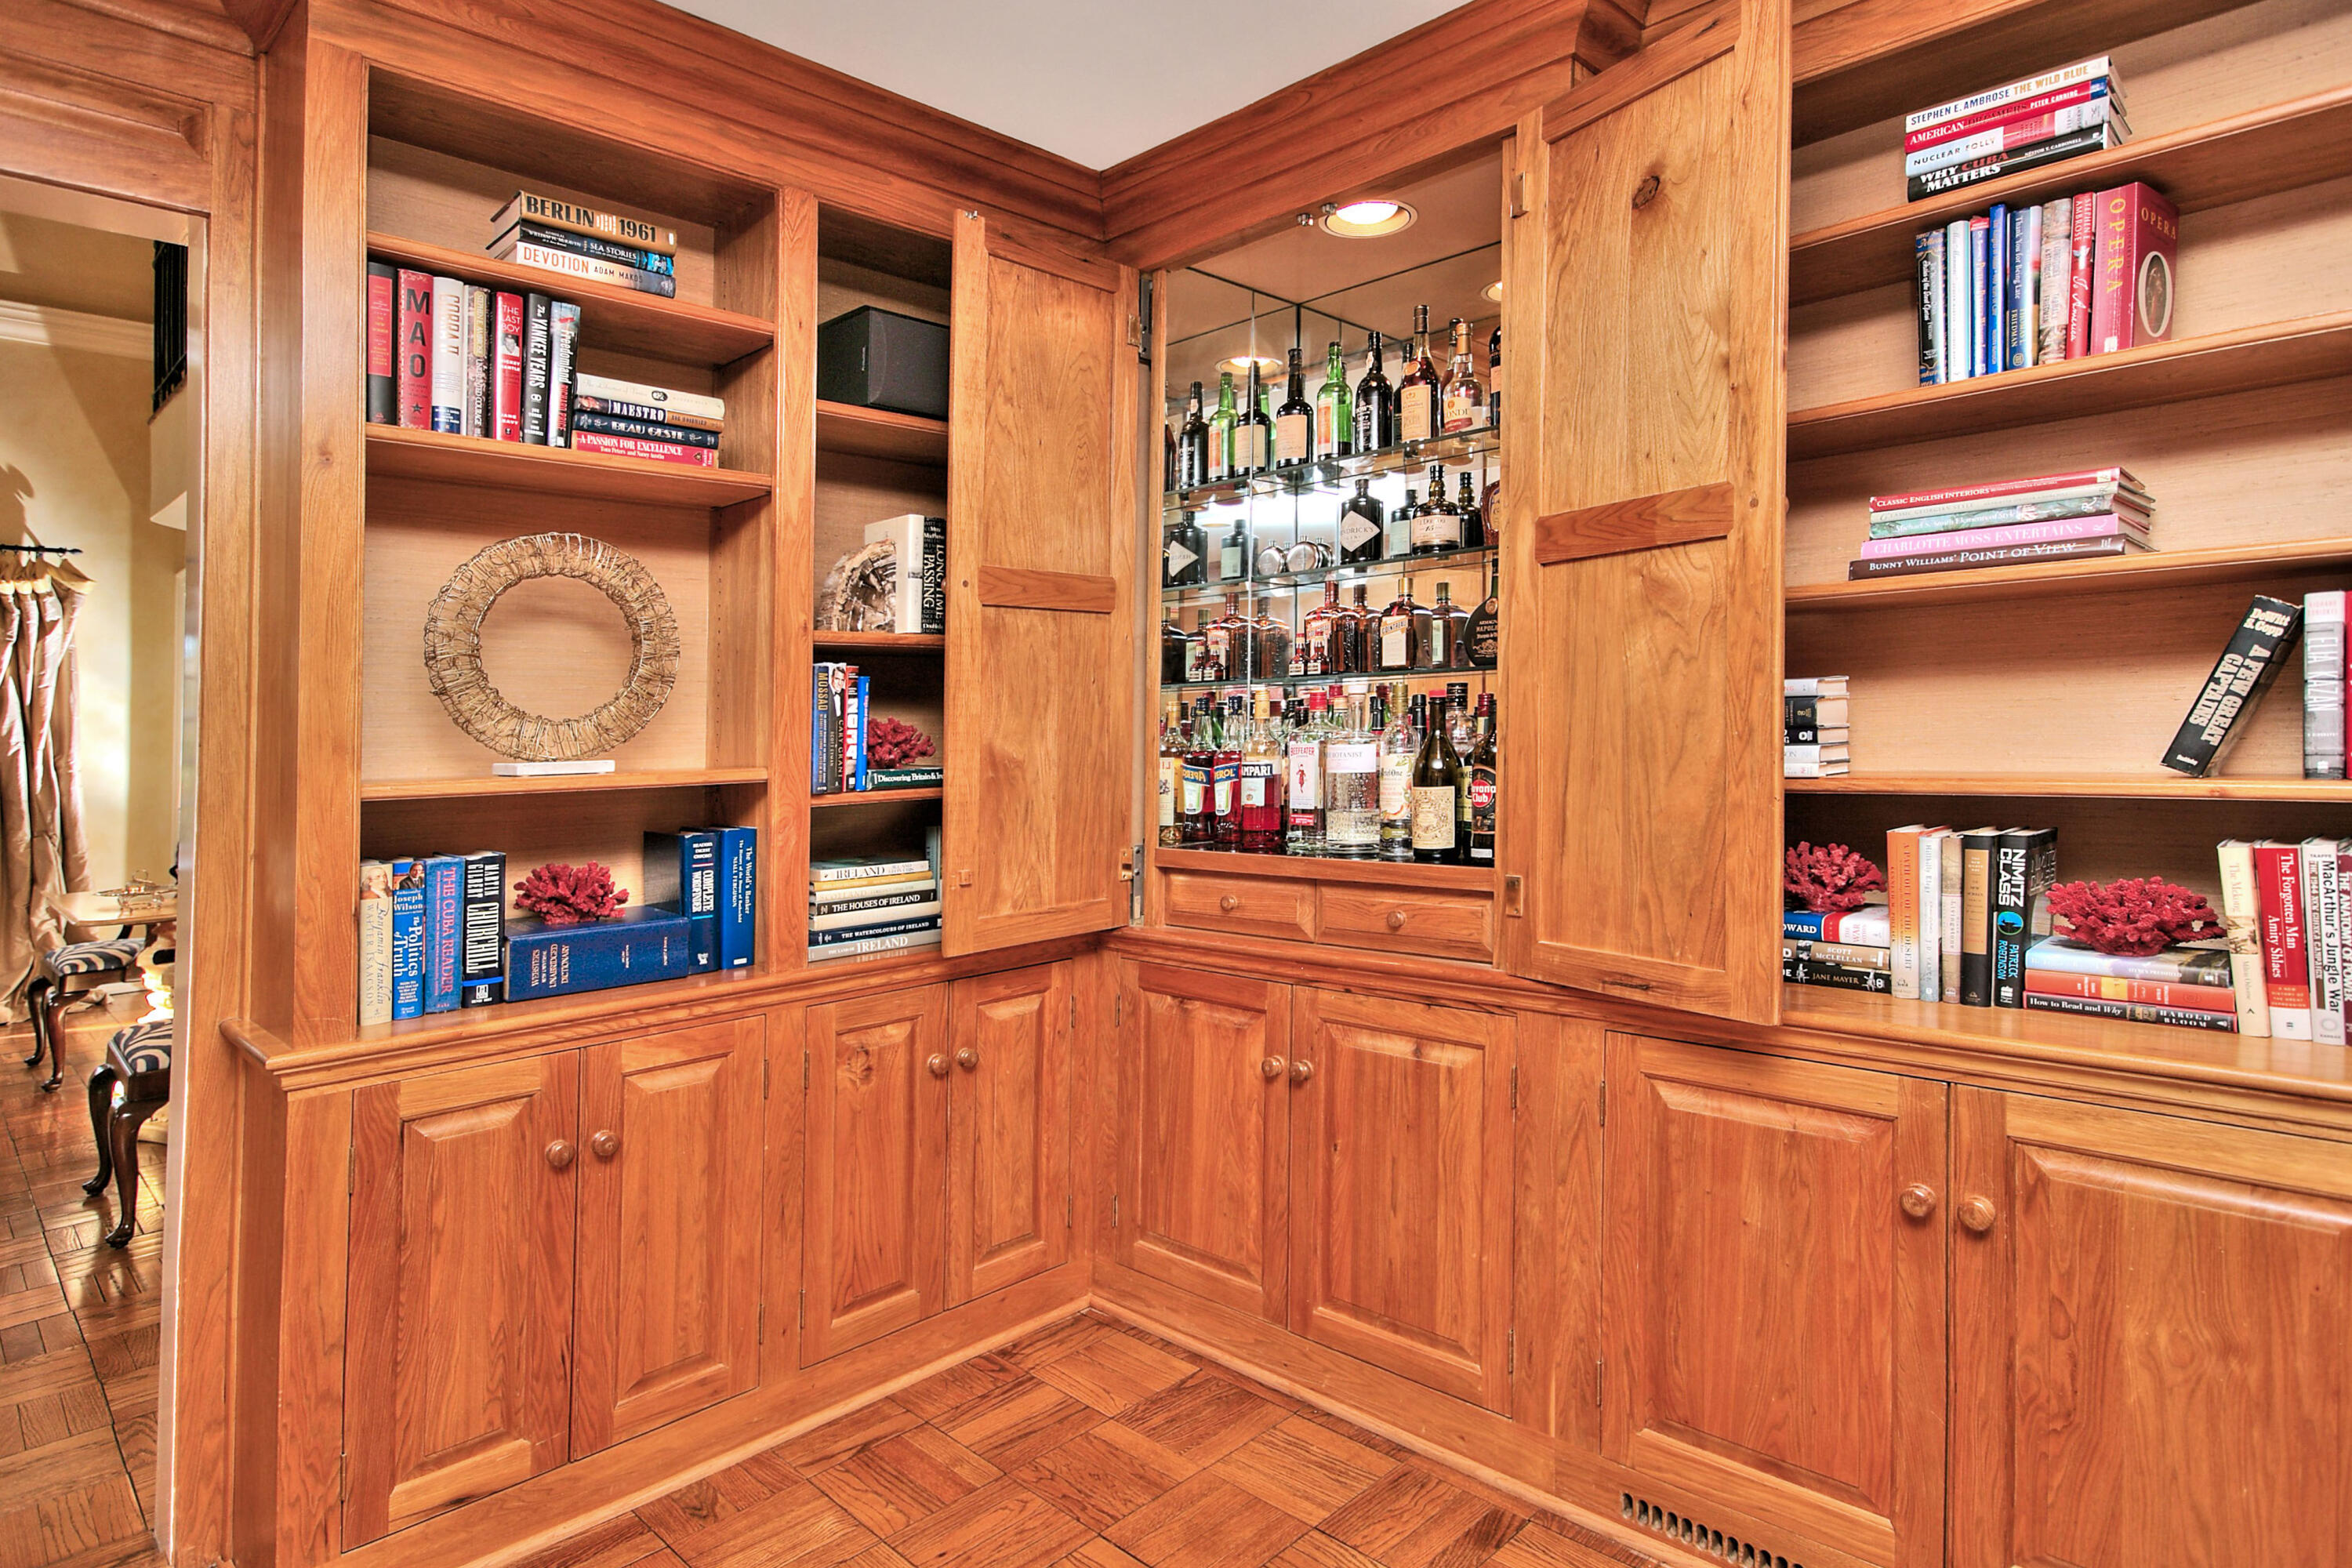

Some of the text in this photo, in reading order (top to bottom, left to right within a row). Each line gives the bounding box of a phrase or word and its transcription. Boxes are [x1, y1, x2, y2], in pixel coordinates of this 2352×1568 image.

[1911, 65, 2089, 125] STEPHEN AMBROSE THE WILD BLUE
[1910, 99, 2049, 145] AMERICAN PETER
[1914, 136, 1995, 166] NUCLEAR FOLLY
[1920, 151, 2009, 183] WHY CUBA
[1926, 164, 2002, 193] MATTERS
[527, 195, 656, 242] BERLIN 1961
[2015, 216, 2024, 238] Thank
[2074, 201, 2083, 241] AMBROSE
[2083, 198, 2092, 234] STEPHEN
[2141, 207, 2176, 240] OPERA
[590, 242, 637, 260] SEA STORIES
[2015, 239, 2024, 252] You
[2107, 198, 2126, 293] OPERA
[524, 246, 644, 283] DEVOTION ADAM MAKOS
[2013, 264, 2023, 284] Being
[439, 293, 461, 340] COBRA
[502, 315, 521, 324] LAST
[503, 305, 520, 314] THE
[537, 304, 546, 318] The
[2071, 293, 2086, 343] America
[405, 288, 430, 379] MAO
[502, 323, 521, 333] BOY
[531, 319, 548, 354] YANKEE
[529, 355, 546, 389] YEARS
[559, 329, 575, 385] Freedomland
[474, 397, 484, 426] COURAGE
[612, 401, 664, 422] MAESTRO
[581, 434, 684, 456] A PASSION FOR EXCELLENCE
[611, 421, 684, 441] BEAU GESTE
[1877, 497, 1908, 507] CLASSIC
[1910, 493, 1944, 503] ENGLISH
[1944, 488, 1990, 500] INTERIORS
[1955, 510, 2016, 525] Elements Style
[1875, 521, 2084, 554] CHARLOTTE MOSS ENTERTAINS
[935, 544, 945, 582] LONG
[1869, 542, 2078, 571] BUNNY WILLIAMS' POINT OF VIEW
[923, 554, 936, 608] PASSING
[1381, 620, 1407, 634] COINTREAU
[2249, 608, 2291, 626] DeWitt
[2255, 619, 2285, 637] Copp
[2189, 653, 2245, 728] CAPTAINS
[2307, 637, 2339, 712] ELIA KAZAN
[818, 673, 829, 711] MOSSAD
[2200, 644, 2271, 746] A FEW GREAT
[1290, 746, 1315, 757] BEEFEATER
[878, 772, 931, 783] Discovering Britain
[1472, 793, 1488, 803] Club
[1476, 815, 1483, 827] 7
[467, 864, 485, 898] GILBERT
[485, 864, 499, 895] MARTIN
[837, 866, 885, 879] IRELAND
[1998, 848, 2012, 906] CLASS
[2010, 849, 2026, 907] NIMITZ
[2229, 863, 2243, 913] The Mekong
[394, 893, 423, 905] Joseph
[692, 870, 702, 913] WORDFINDER
[702, 869, 714, 912] COMPLETE
[832, 894, 920, 913] THE HOUSES OF IRELAND
[2279, 853, 2299, 949] The Forgotten Man
[441, 866, 456, 994] THE CUBA READER
[855, 926, 898, 938] WATERCOLOURS
[906, 921, 930, 931] IRELAND
[2310, 876, 2322, 979] 1944 NEW GUINEA CAMPAIGN
[2339, 872, 2352, 964] THE ANATOMY OF
[376, 902, 390, 1004] Benjamin Franklin
[408, 926, 423, 977] Politics
[466, 902, 499, 974] CHURCHILL
[856, 936, 908, 953] IRELAND
[1828, 946, 1852, 956] SCOTT
[2267, 915, 2282, 978] Amity Shlaes
[2322, 860, 2341, 1013] MacArthur's Jungle War
[365, 904, 375, 1007] WALTER ISAACSON
[394, 935, 408, 977] Truth
[549, 943, 559, 988] UNABRIDGED
[561, 944, 570, 985] DICTIONARY
[1815, 953, 1863, 964] McCLELLAN
[1997, 940, 2008, 981] ROBINSON
[2007, 943, 2020, 979] PATRICK
[1812, 972, 1860, 985] JANE MAYER
[2030, 997, 2049, 1006] How
[2061, 1001, 2082, 1011] Read
[2103, 1005, 2123, 1016] Why
[2159, 1010, 2212, 1022] HAROLD
[2164, 1018, 2208, 1028] BLOOM
